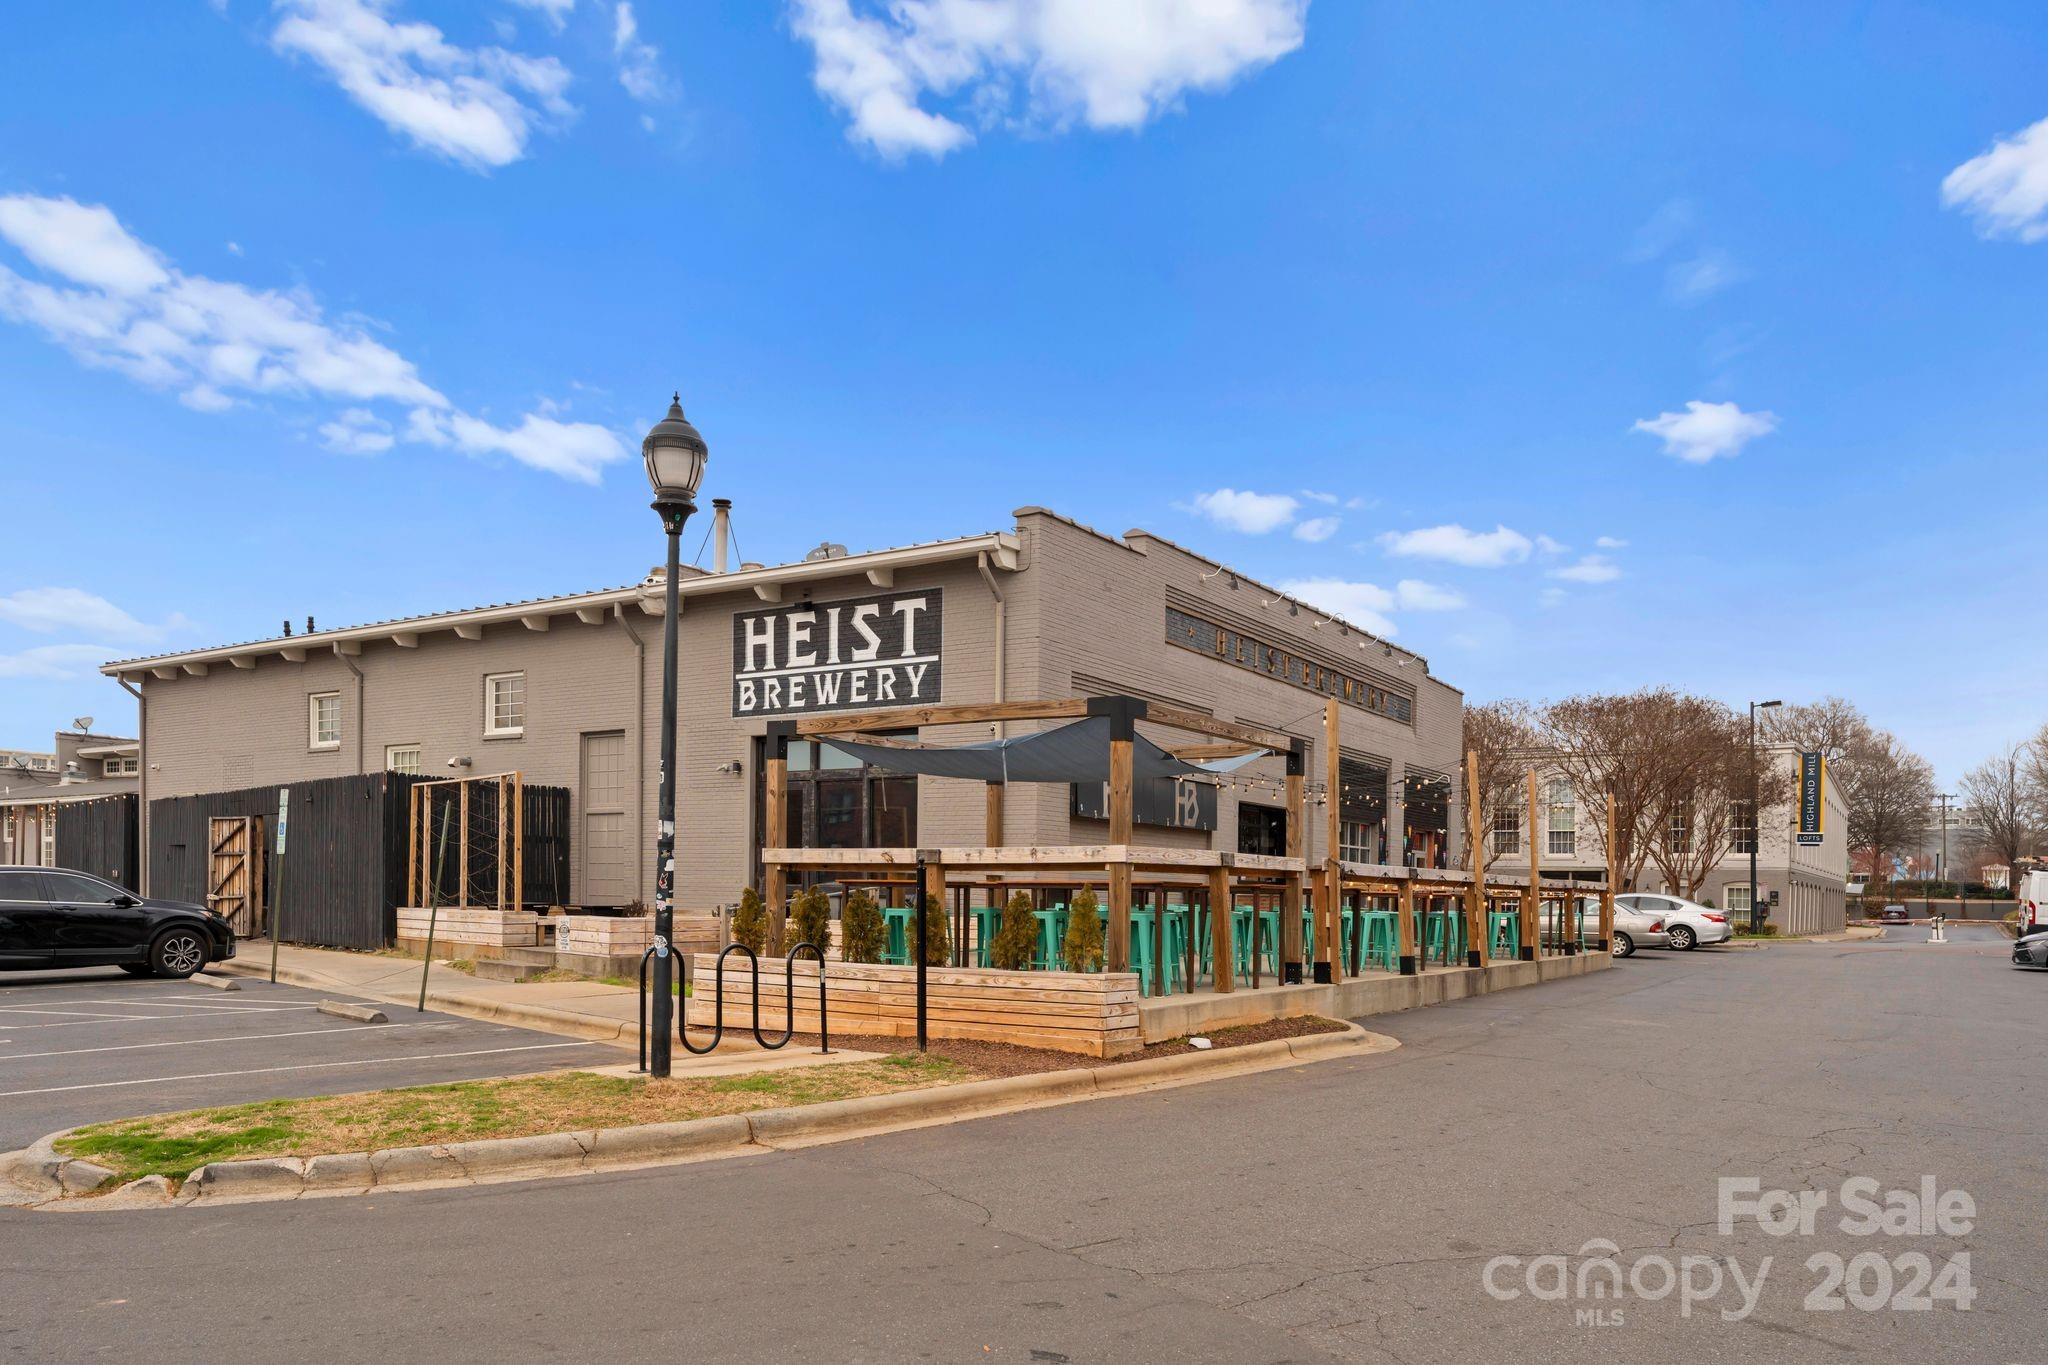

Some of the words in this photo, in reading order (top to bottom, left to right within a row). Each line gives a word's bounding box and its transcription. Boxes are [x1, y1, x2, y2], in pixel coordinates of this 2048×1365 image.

[742, 598, 927, 672] HEIST
[738, 664, 928, 711] BREWERY
[1215, 629, 1291, 678] HEIST
[1302, 662, 1388, 713] BREWERY
[1808, 754, 1816, 776] MILL
[1806, 780, 1816, 831] HIGHLAND
